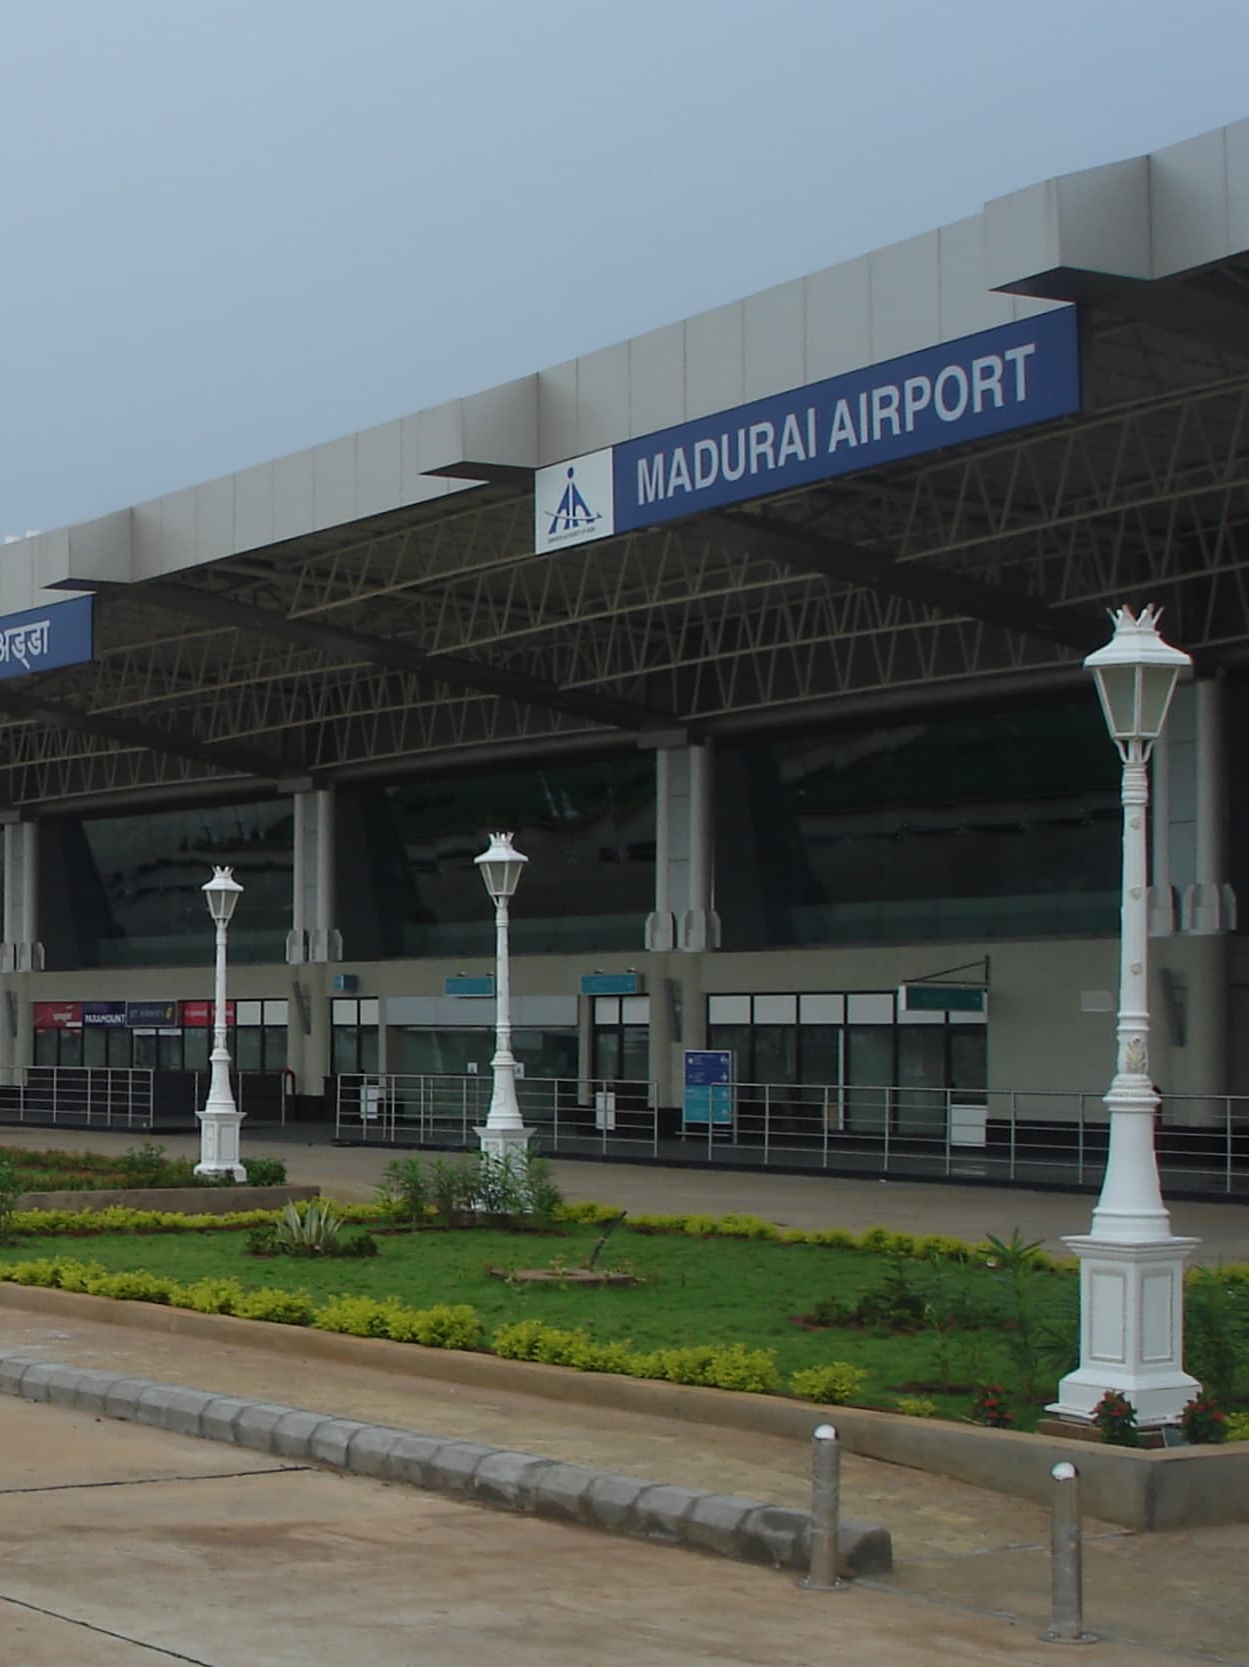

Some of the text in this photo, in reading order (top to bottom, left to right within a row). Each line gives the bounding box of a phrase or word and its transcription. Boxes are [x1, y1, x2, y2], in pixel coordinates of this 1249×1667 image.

[637, 343, 1036, 505] MADURAI AIRPORT
[85, 1014, 126, 1024] PARAMOUNT
